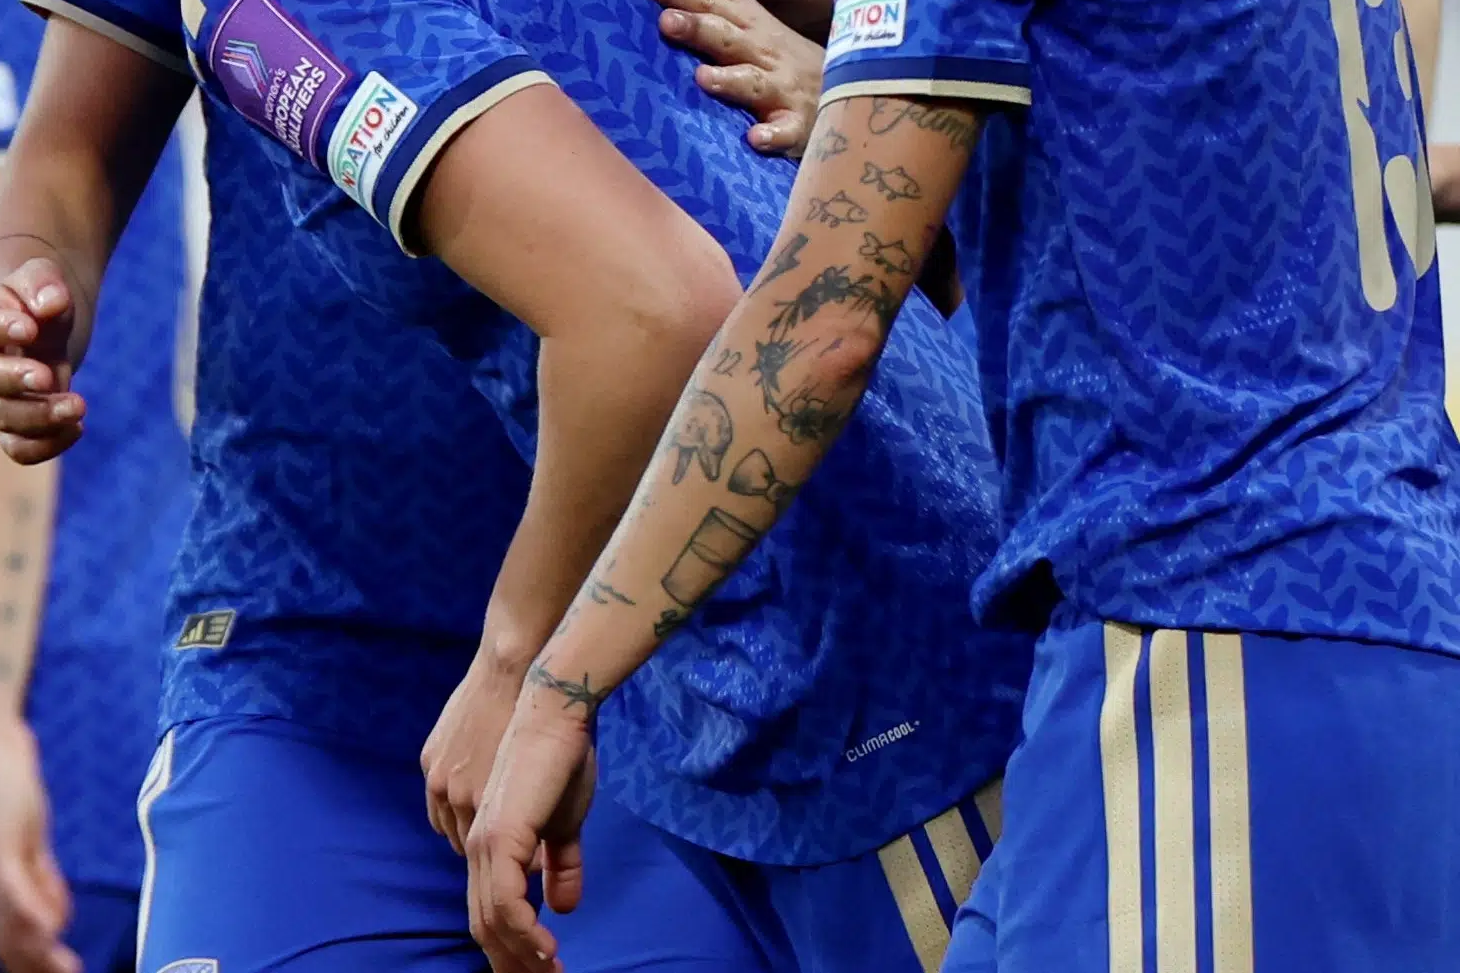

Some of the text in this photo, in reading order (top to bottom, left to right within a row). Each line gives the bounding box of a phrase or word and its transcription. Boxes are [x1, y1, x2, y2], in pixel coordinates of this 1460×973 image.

[275, 56, 313, 142] UROPEAN
[287, 66, 326, 157] UALIFIERS
[341, 88, 397, 189] NDATION
[373, 106, 409, 160] for children
